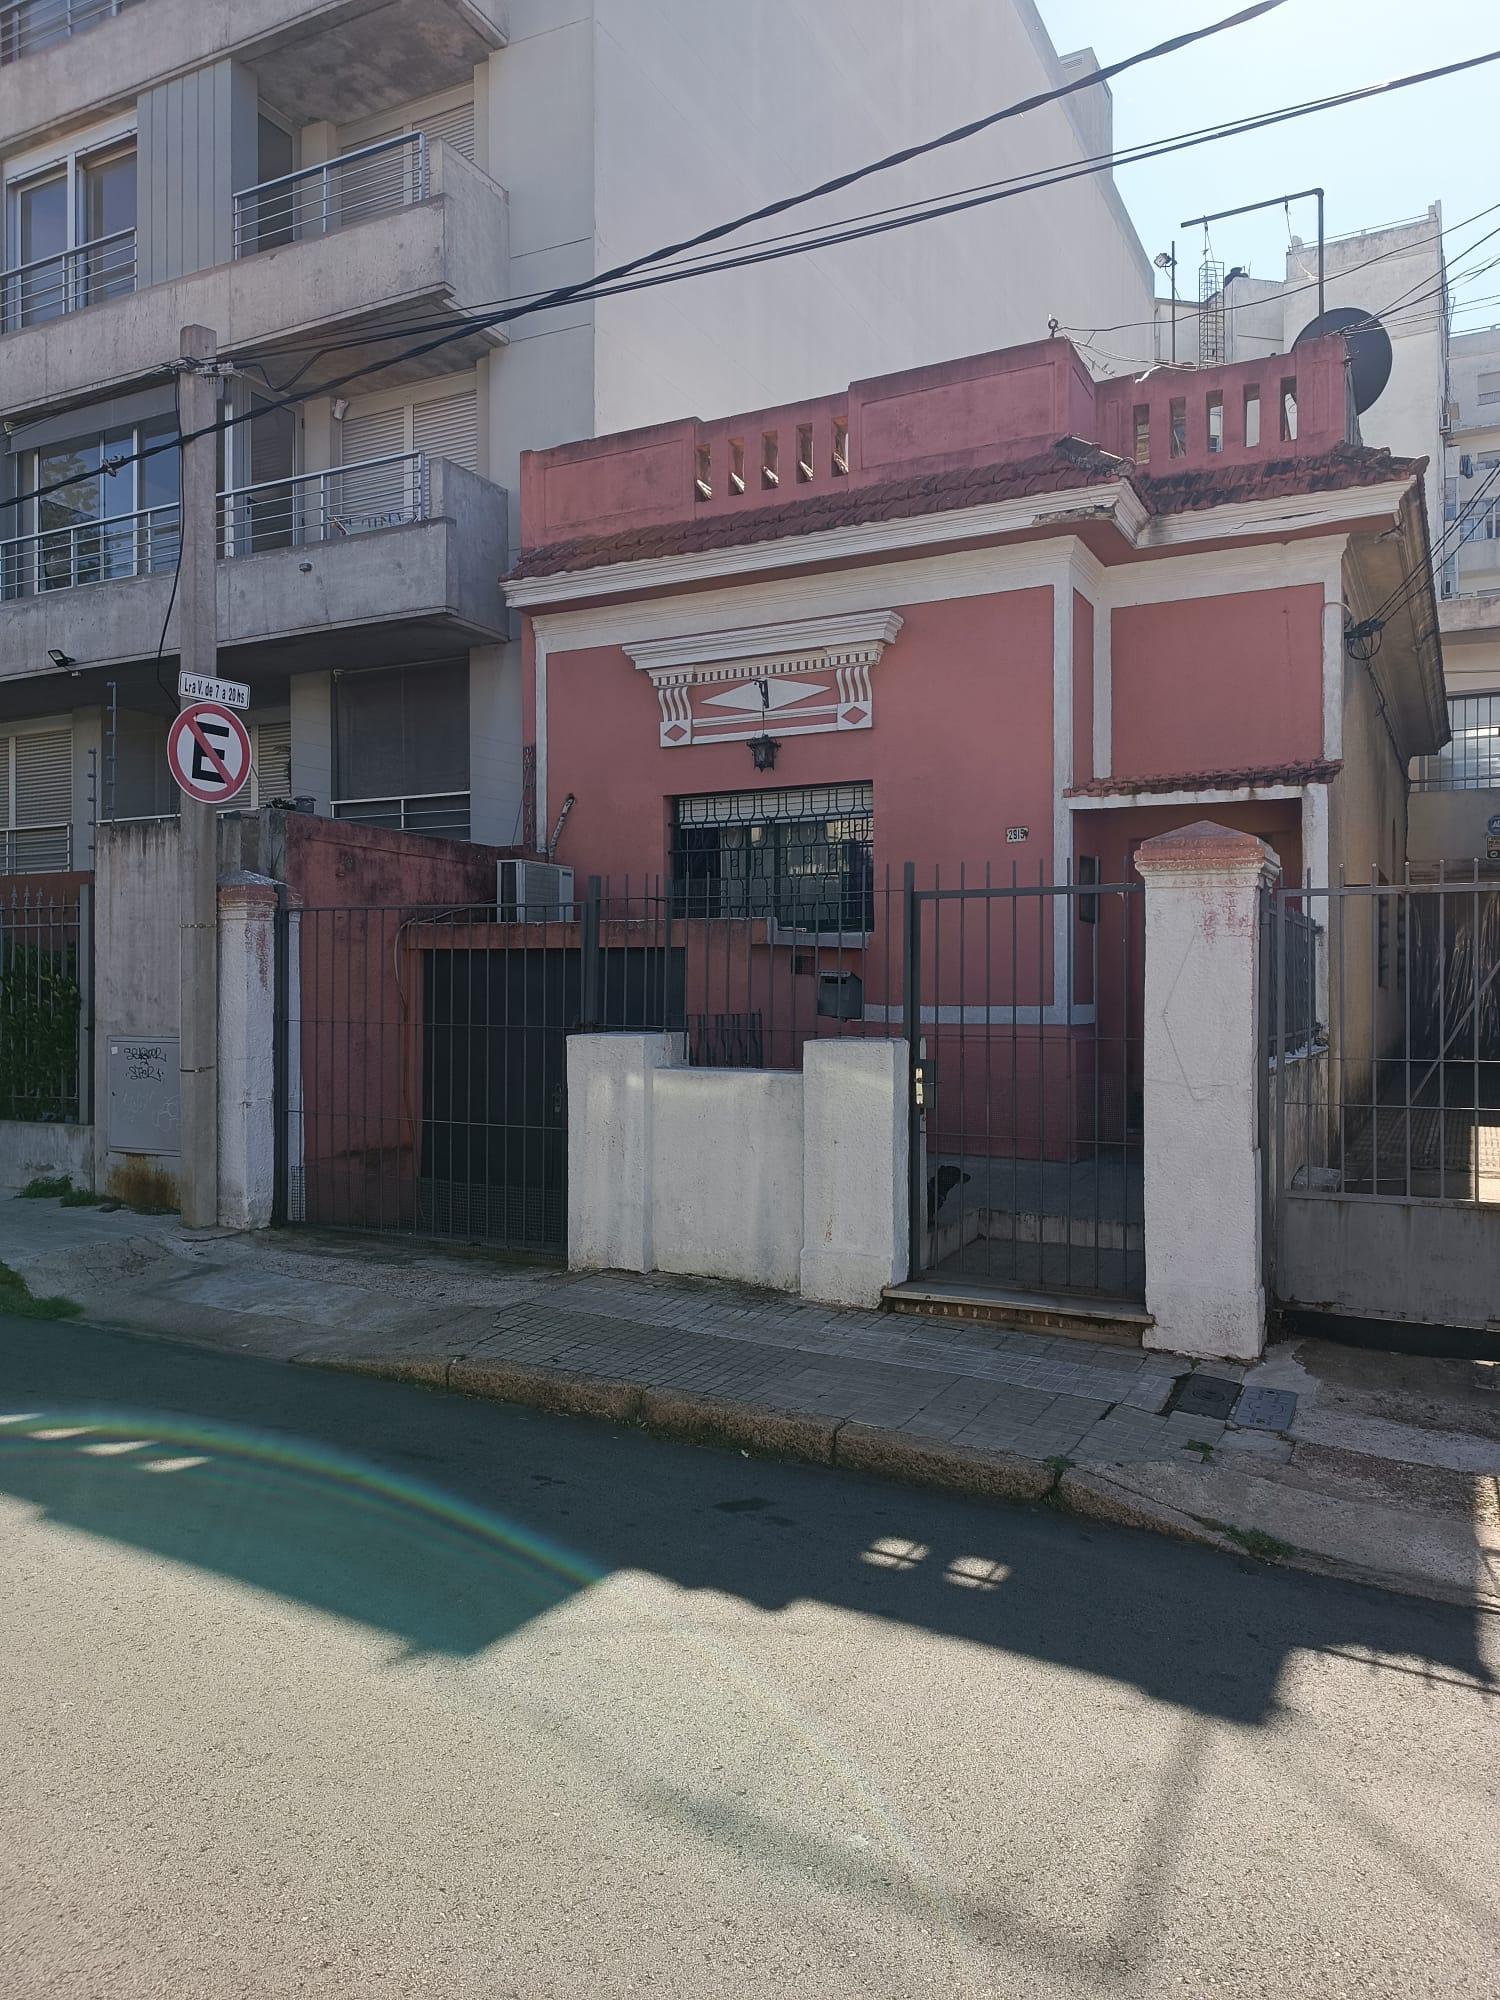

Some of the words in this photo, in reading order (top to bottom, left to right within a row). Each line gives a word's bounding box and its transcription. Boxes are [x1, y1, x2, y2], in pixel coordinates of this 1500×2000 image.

[205, 681, 213, 697] de
[215, 684, 220, 698] 7
[222, 688, 226, 700] a
[192, 721, 229, 783] E
